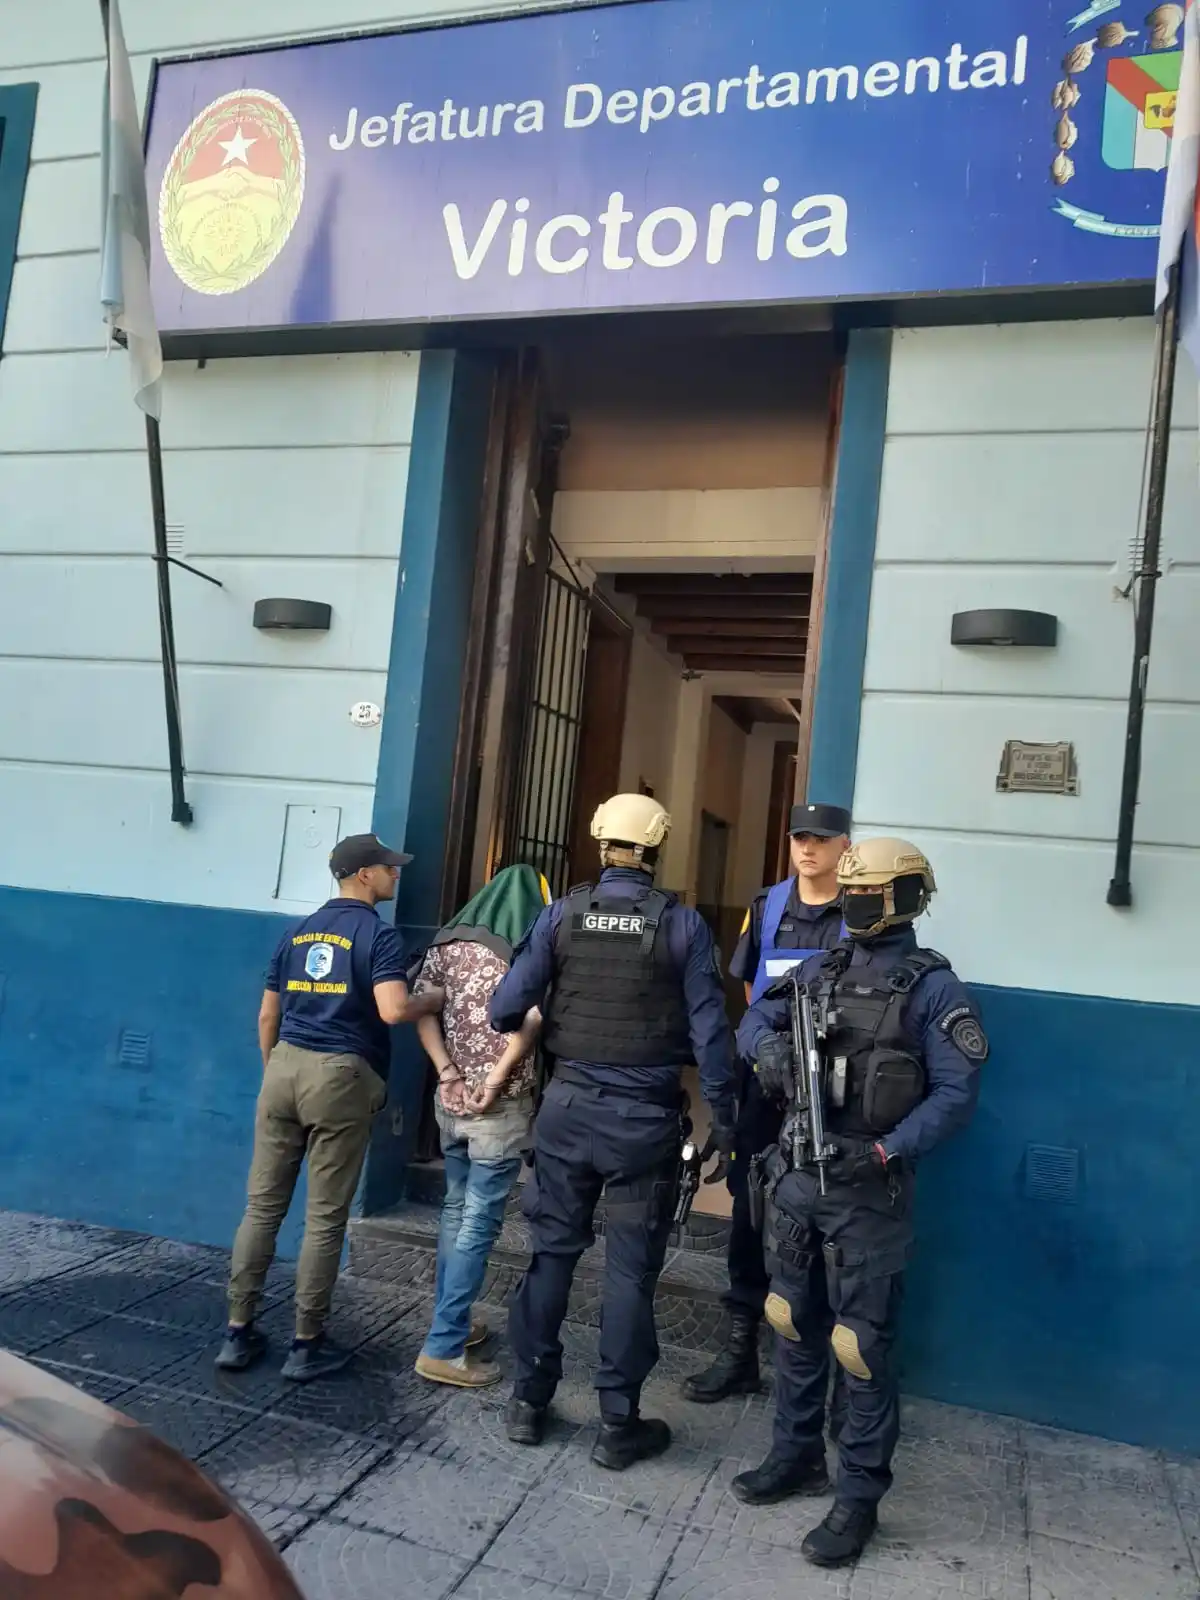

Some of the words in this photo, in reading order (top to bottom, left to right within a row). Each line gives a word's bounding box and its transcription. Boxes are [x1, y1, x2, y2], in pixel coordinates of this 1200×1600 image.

[329, 98, 544, 151] Jefatura
[564, 34, 1028, 134] Departamental
[442, 177, 848, 280] Victoria
[585, 915, 641, 932] GEPER
